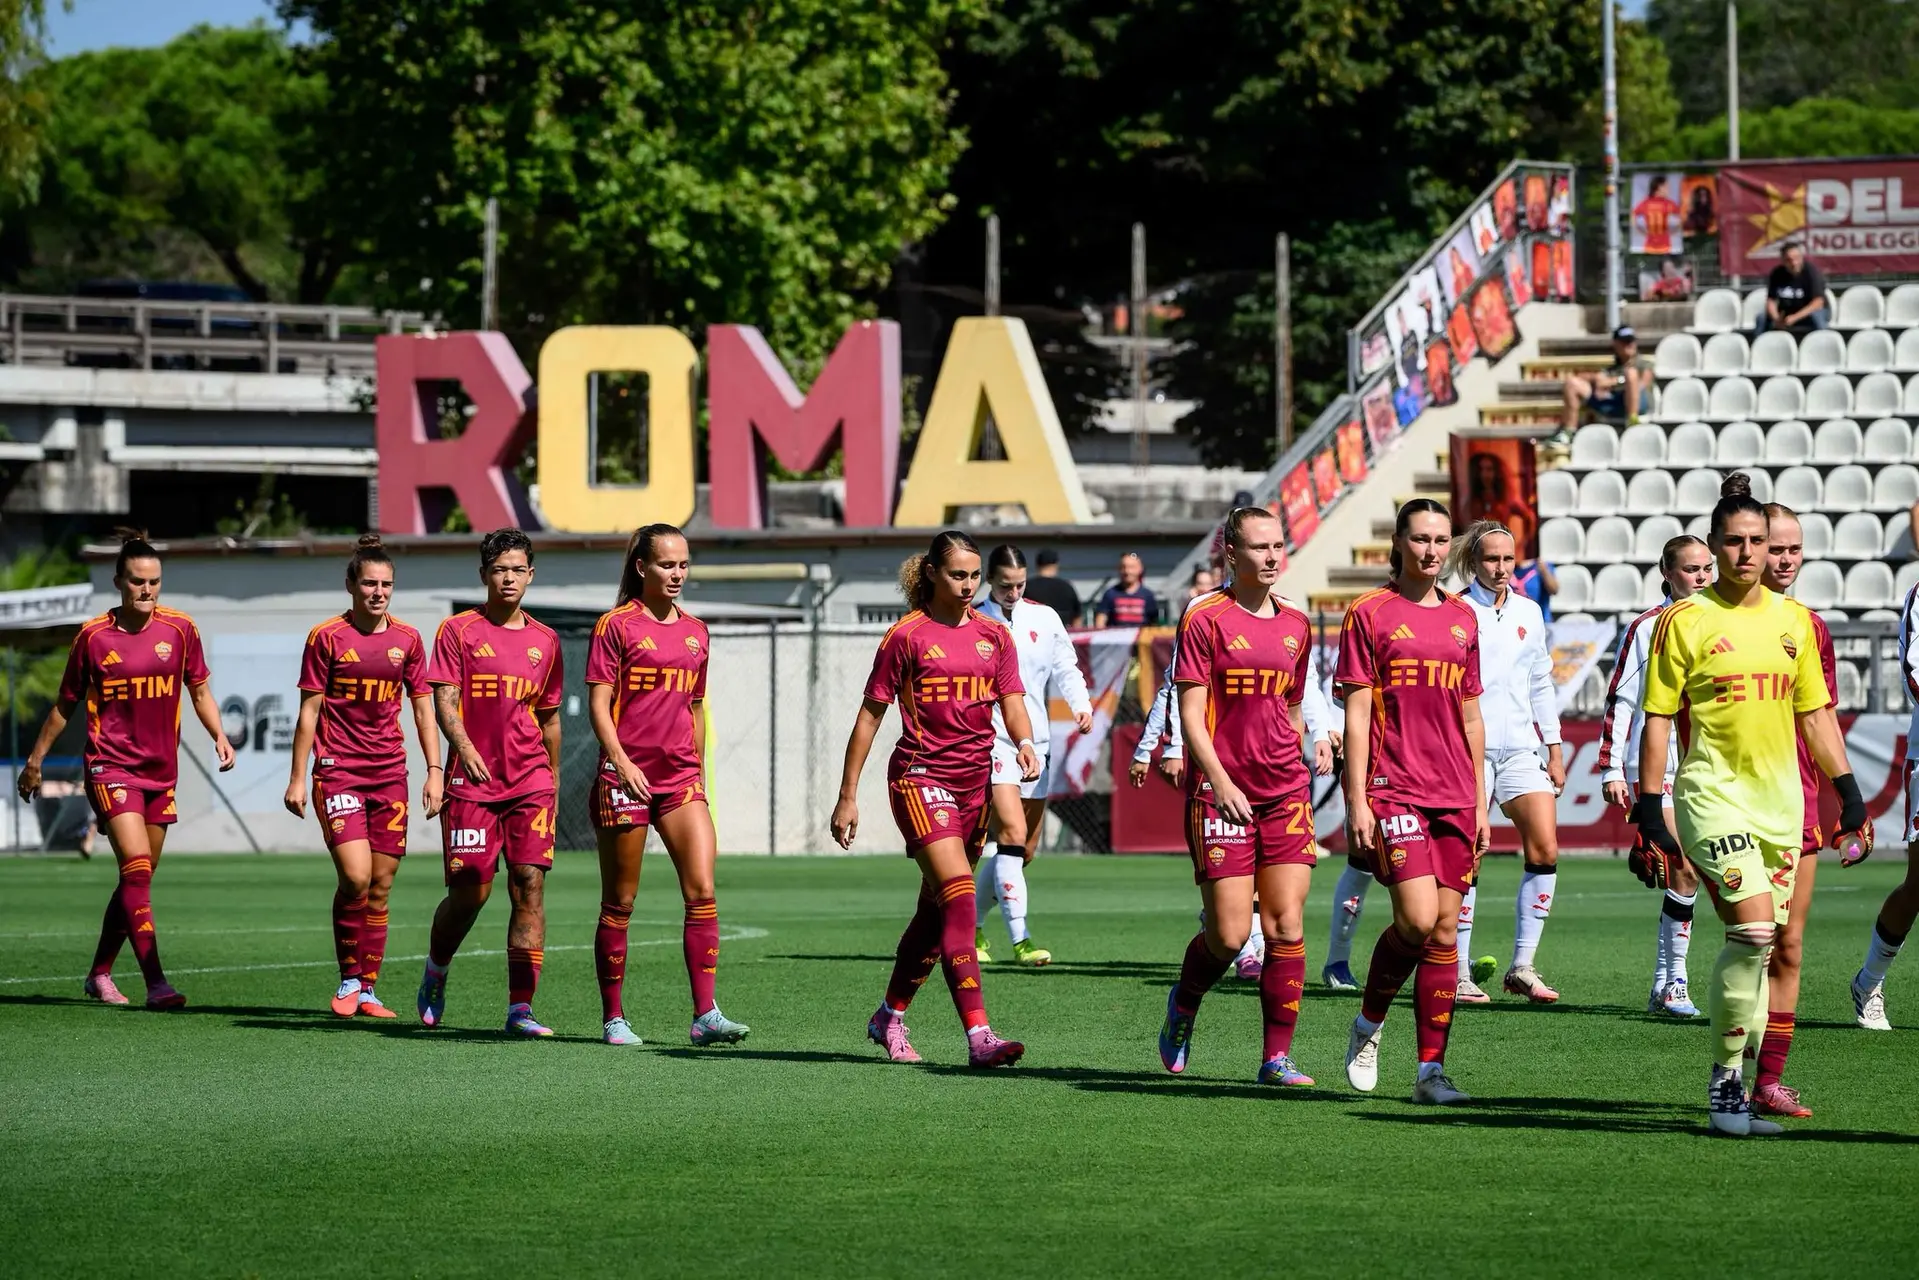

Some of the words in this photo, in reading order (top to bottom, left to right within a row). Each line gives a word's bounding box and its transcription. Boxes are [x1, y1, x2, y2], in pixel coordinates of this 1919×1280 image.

[1812, 231, 1919, 250] NOLEGG
[377, 316, 1093, 535] ROMA
[131, 675, 175, 699] TIM
[661, 667, 699, 693] TIM
[952, 955, 972, 967] ASR
[1433, 989, 1456, 1000] ASR
